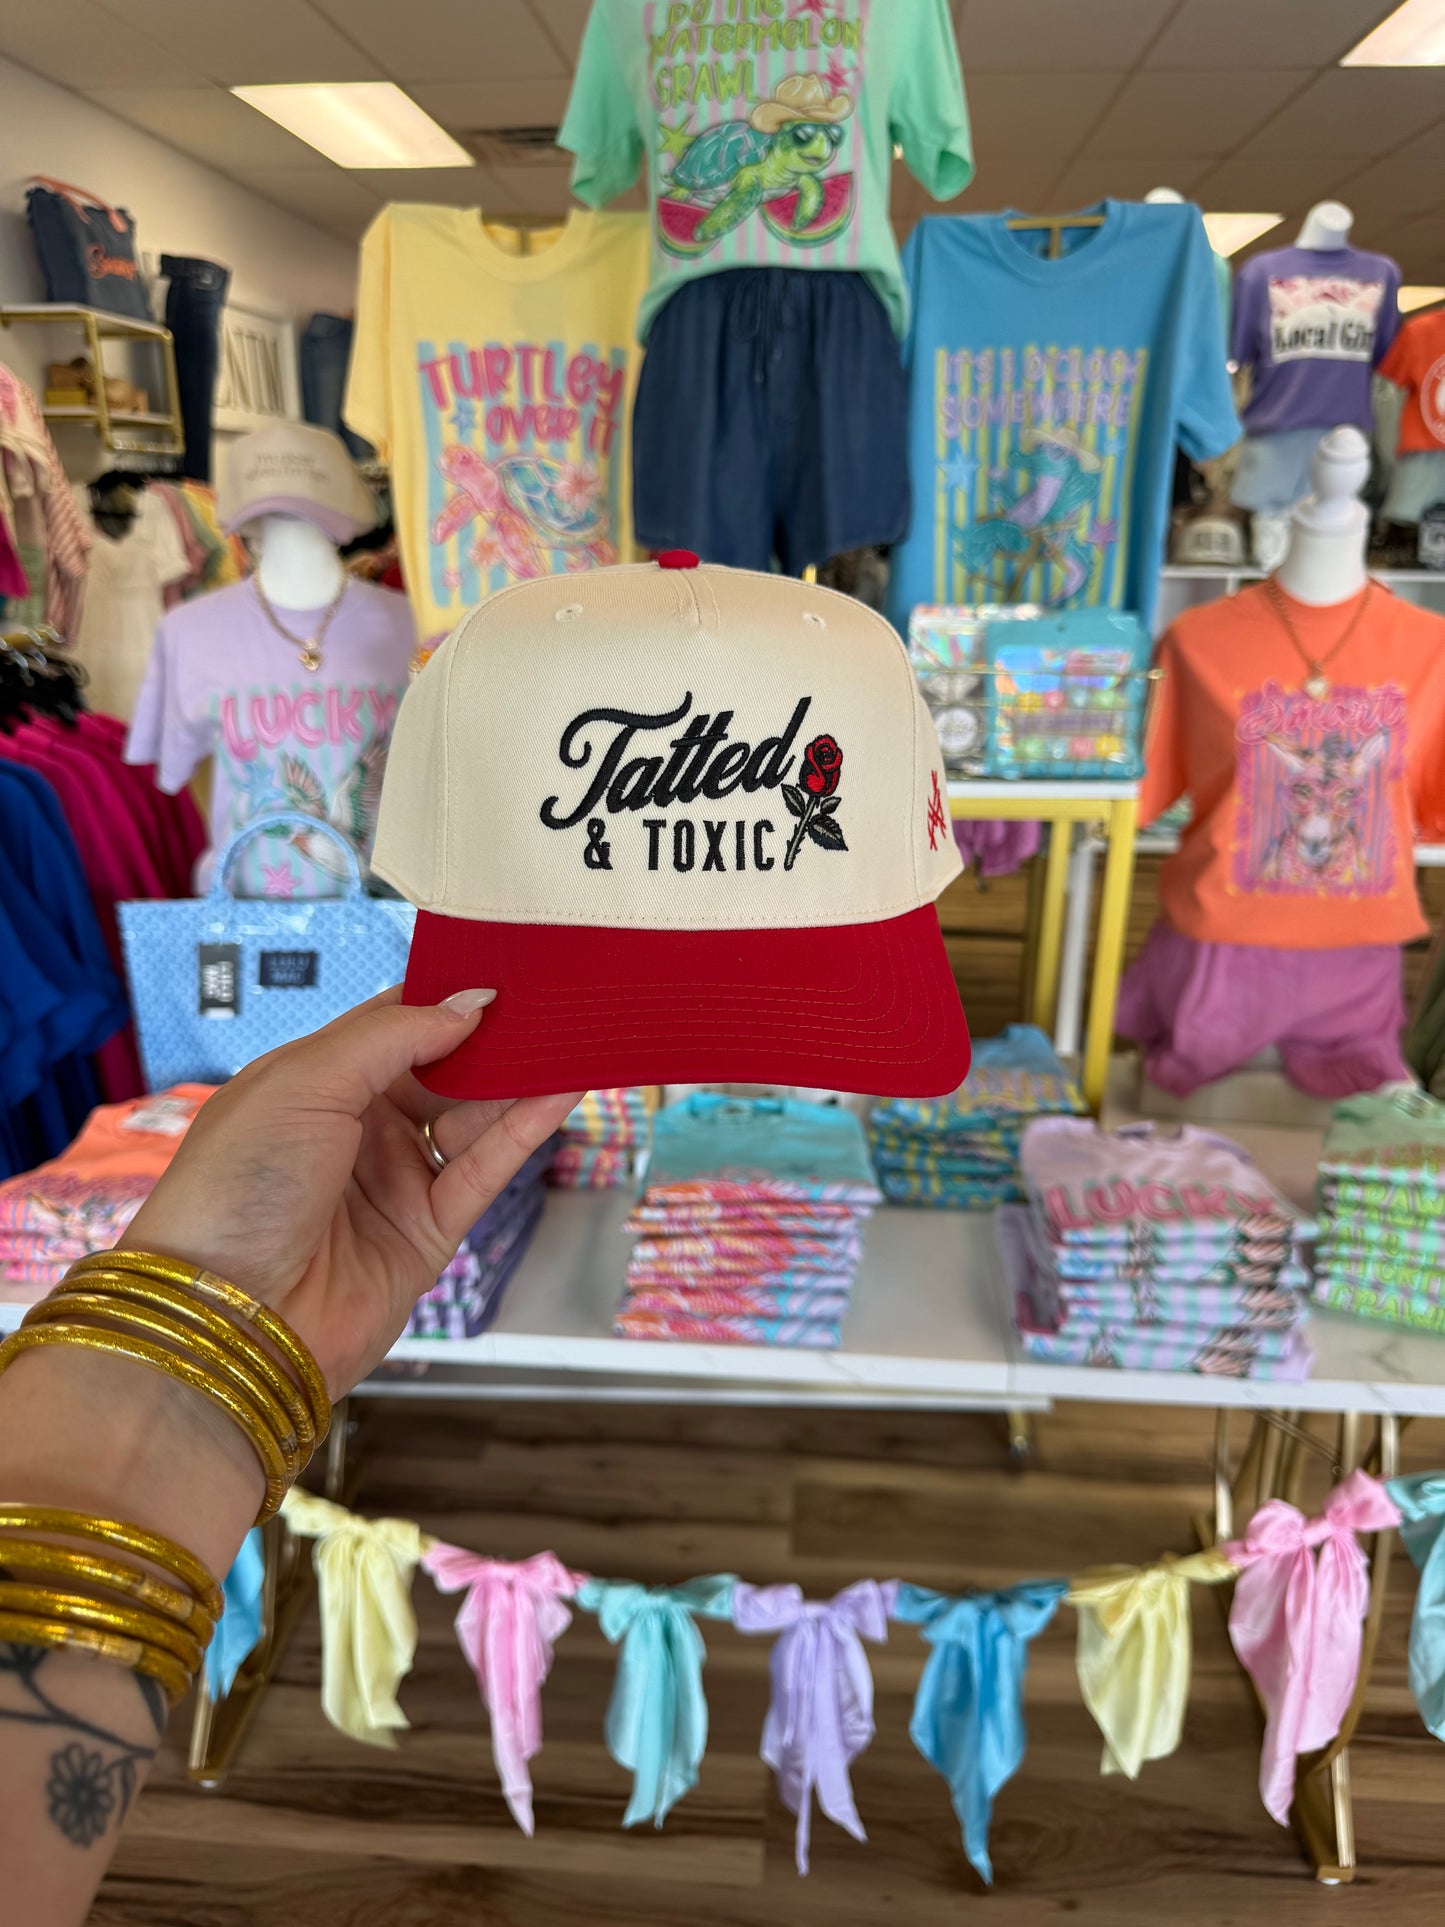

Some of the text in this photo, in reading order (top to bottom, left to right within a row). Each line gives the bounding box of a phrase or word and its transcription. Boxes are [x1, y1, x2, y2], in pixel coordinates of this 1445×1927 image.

[1274, 320, 1338, 351] Local
[221, 686, 397, 764] LUCKY
[540, 690, 811, 830] Tatted
[583, 817, 775, 872] & TOXIC
[1045, 1179, 1275, 1230] LUCKY
